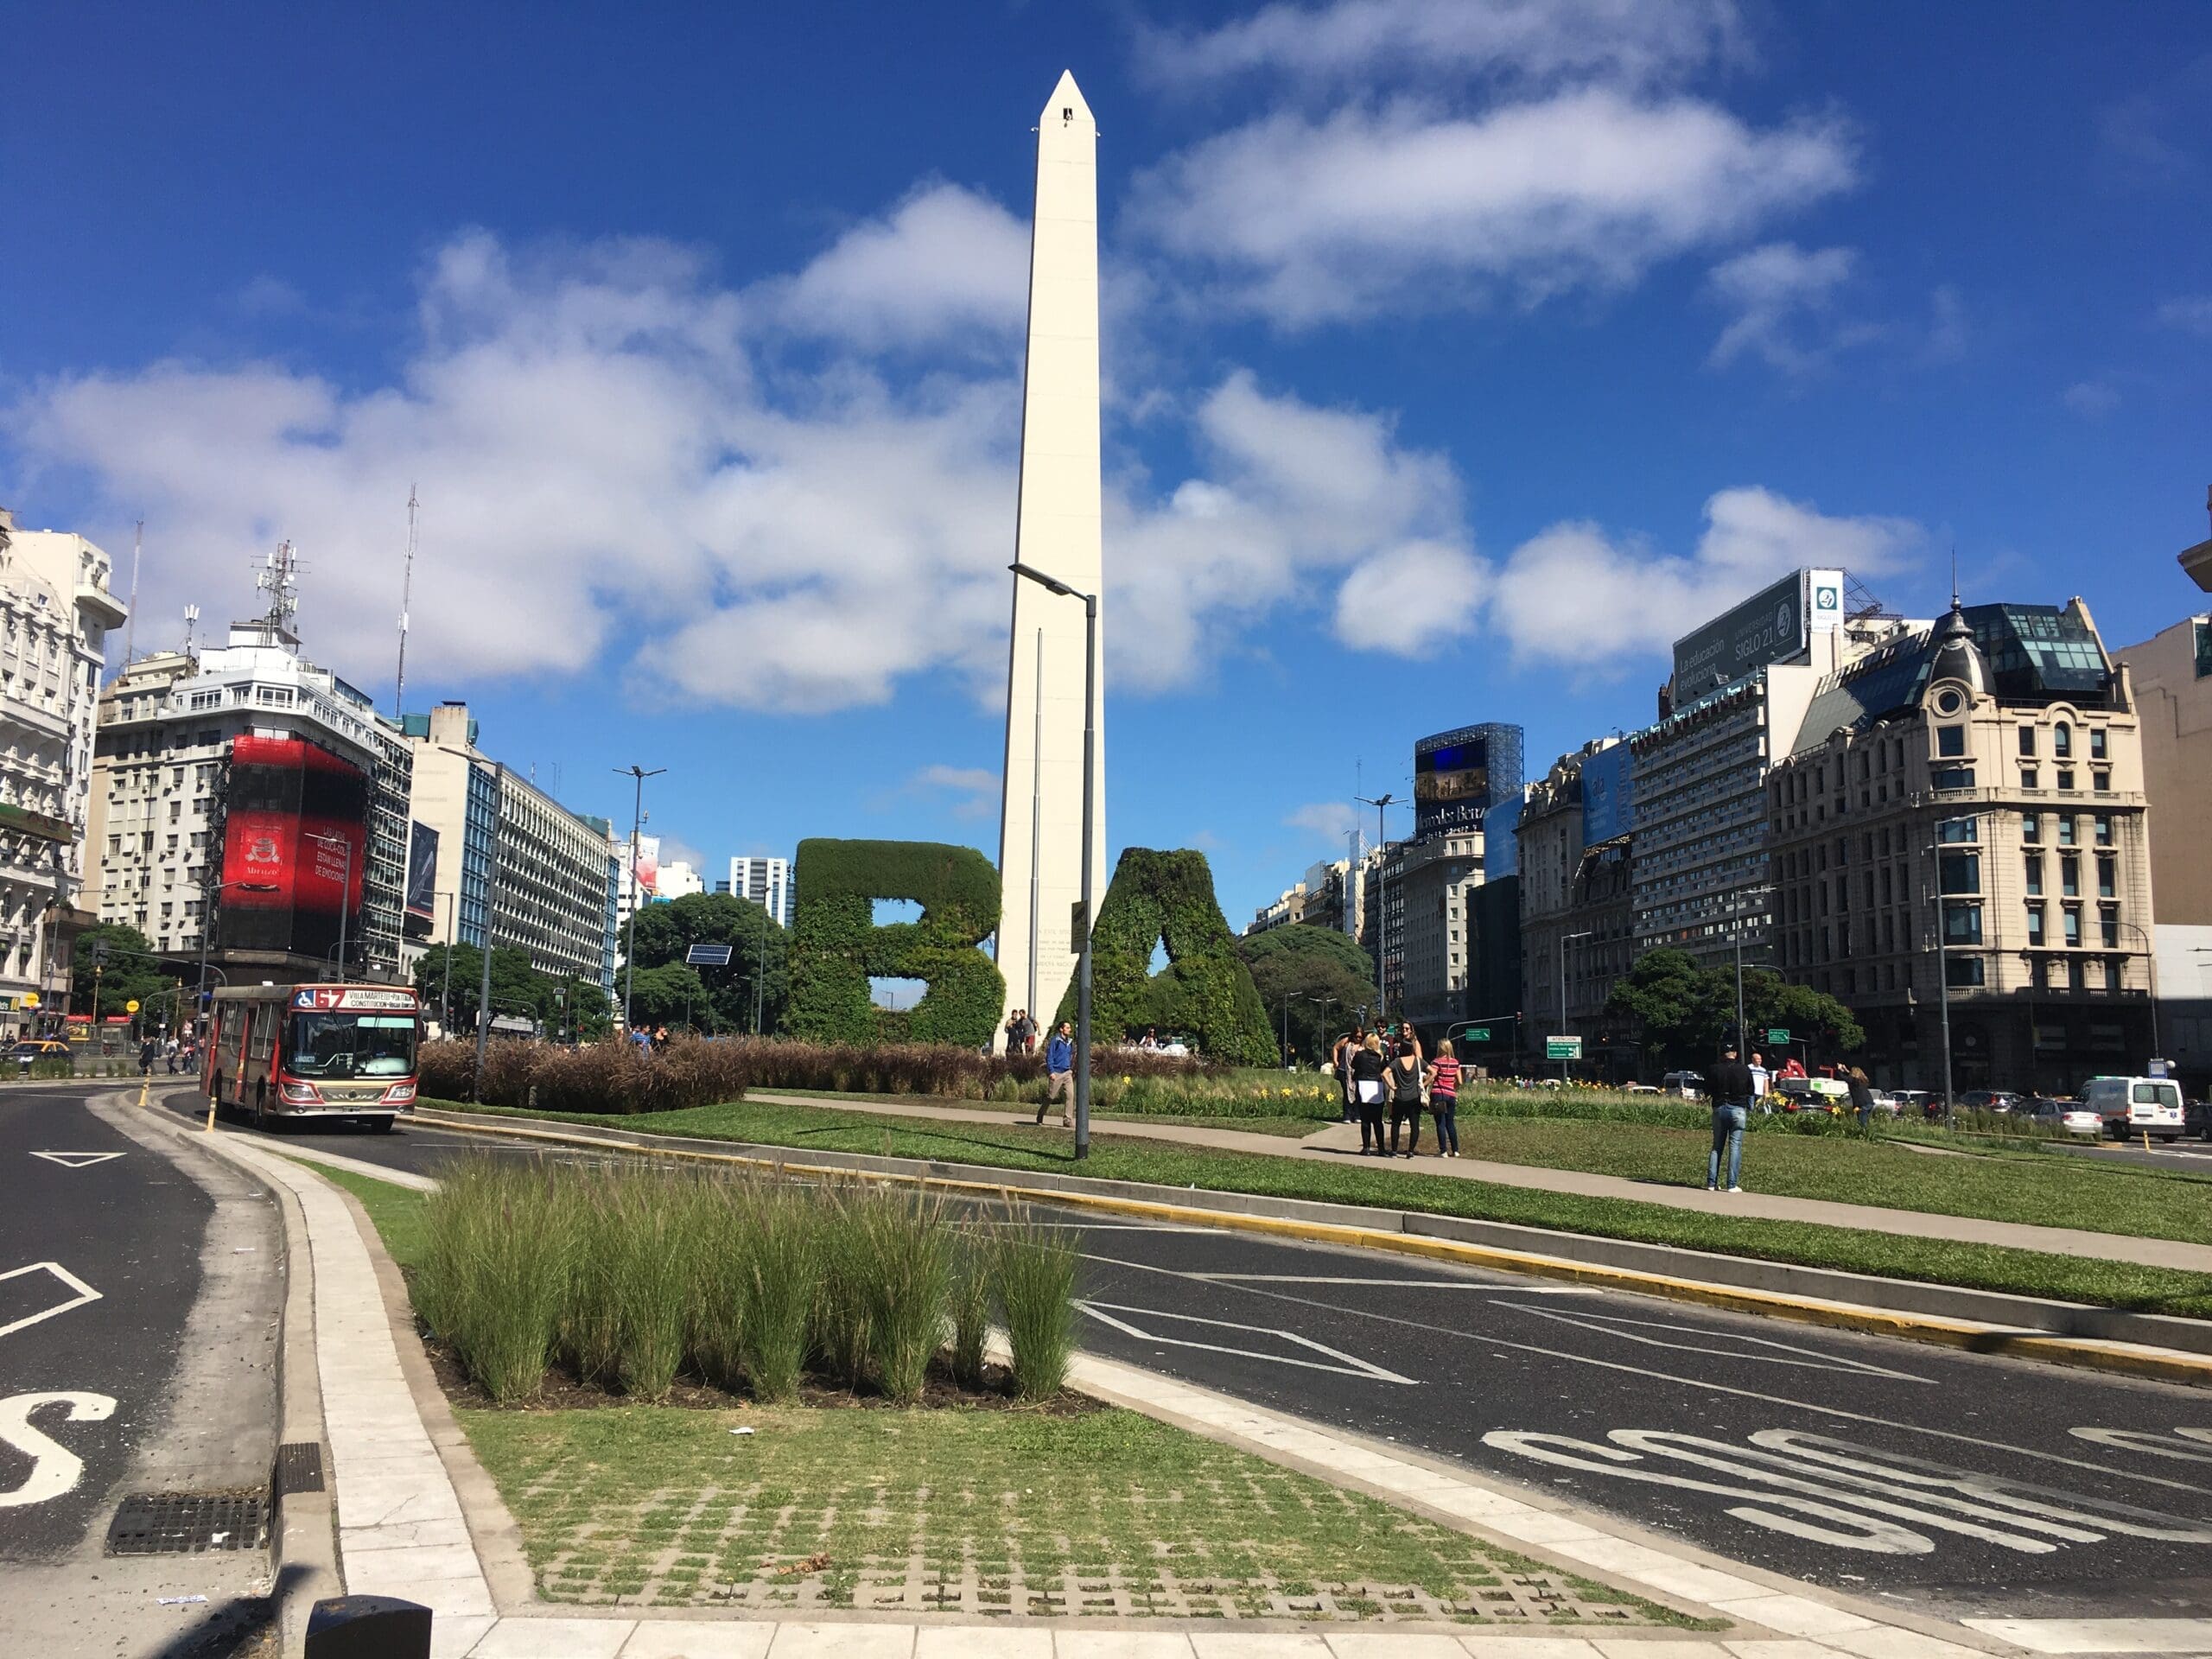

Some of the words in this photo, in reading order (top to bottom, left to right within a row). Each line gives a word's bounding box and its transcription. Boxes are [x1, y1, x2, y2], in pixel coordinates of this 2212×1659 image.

[1680, 658, 1688, 674] La
[1689, 638, 1725, 668] educación
[1735, 633, 1761, 661] SIGLO
[1763, 625, 1774, 647] 21
[1680, 662, 1717, 691] evoluciona
[324, 840, 346, 856] COCA-COL
[315, 989, 346, 1008] 67
